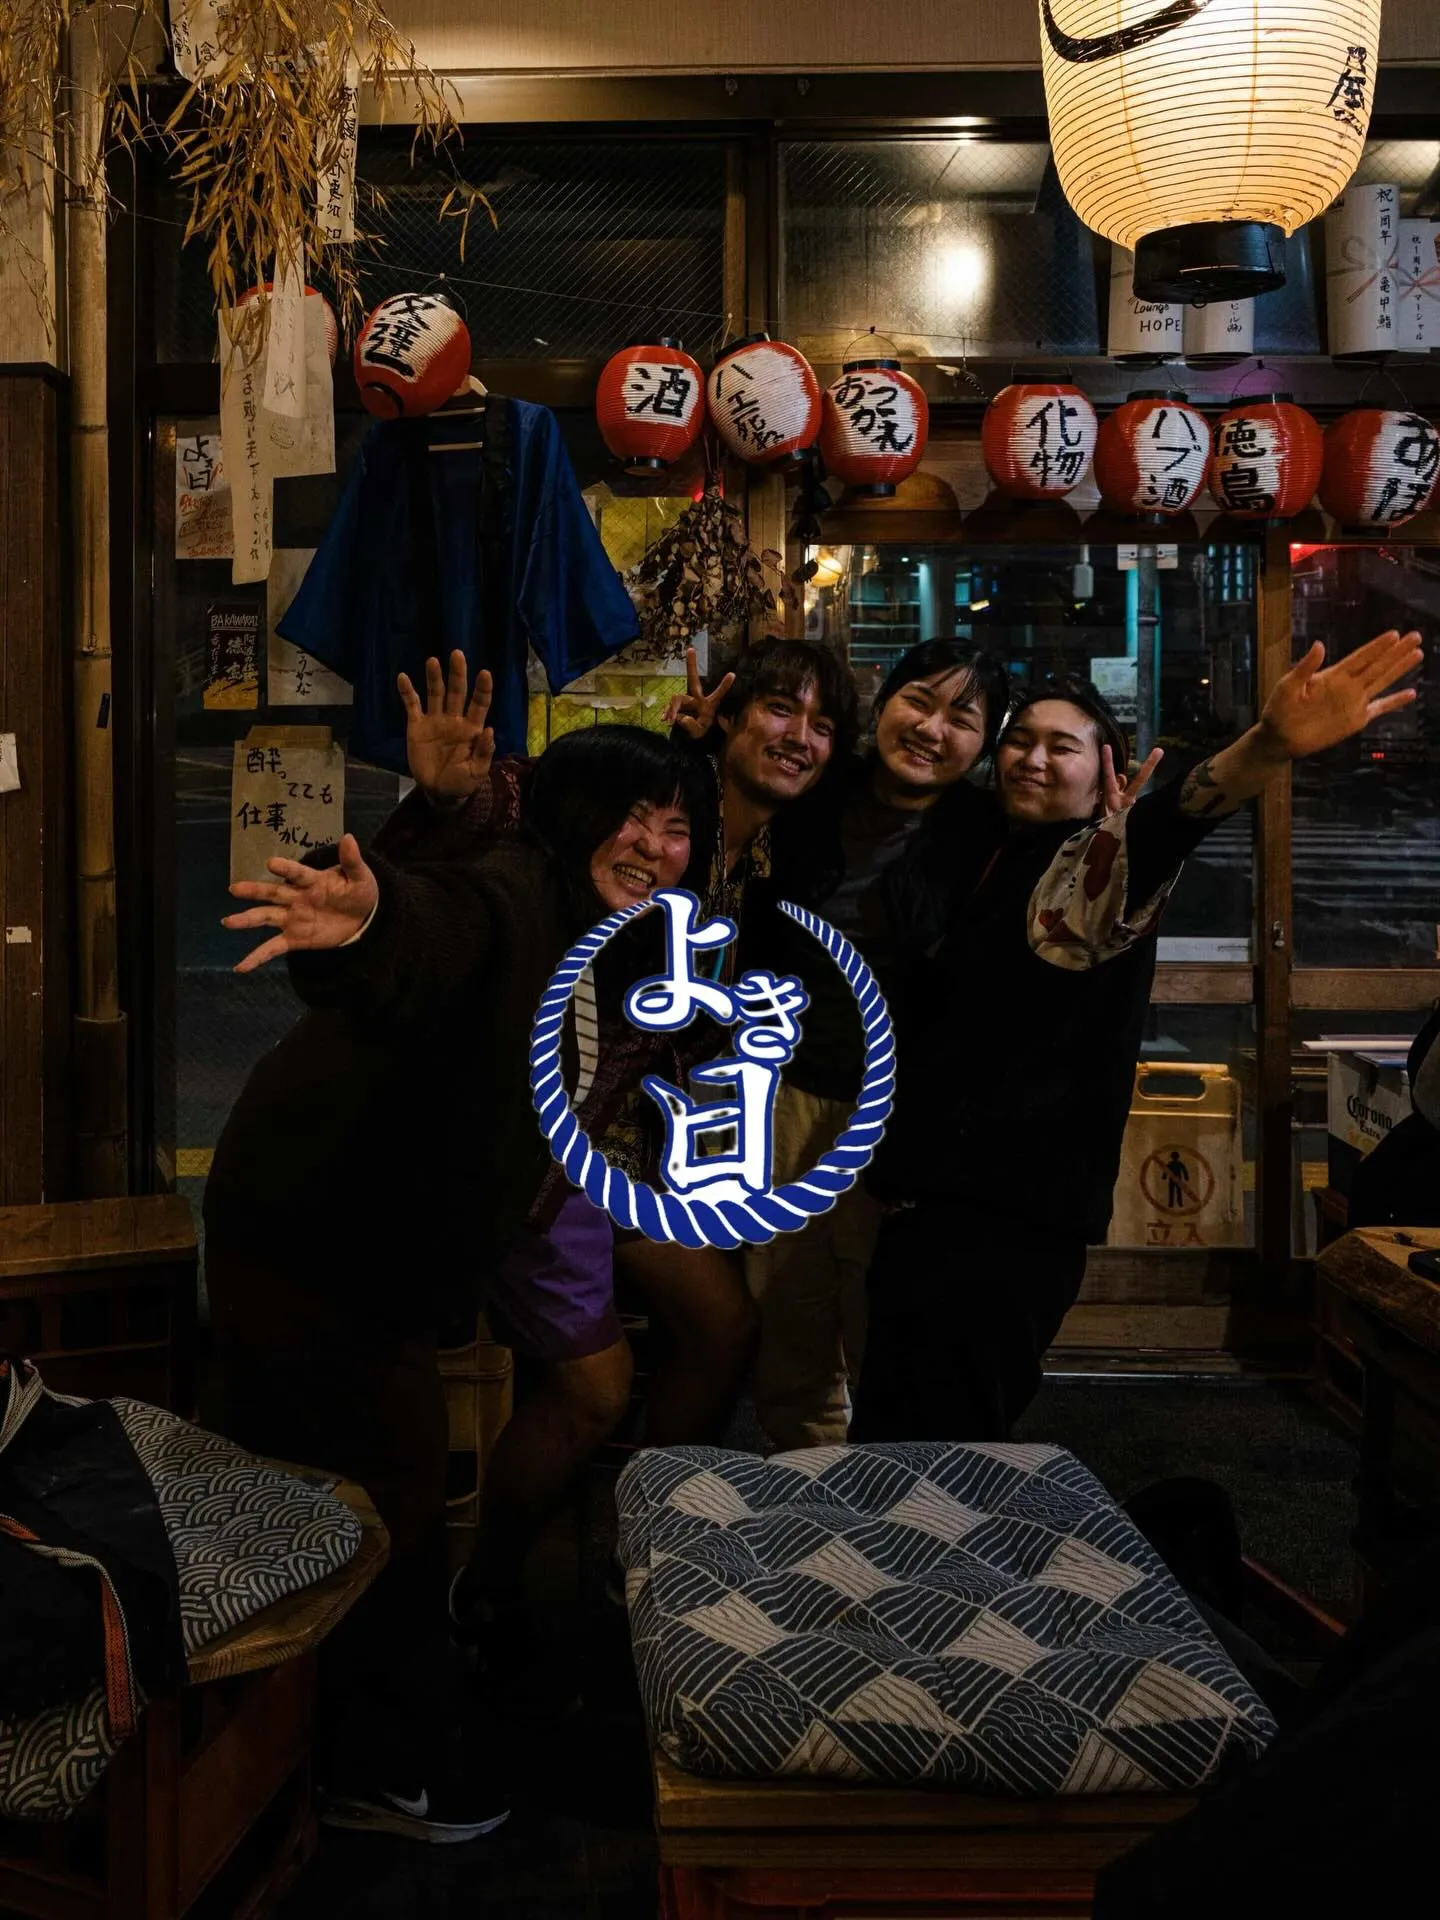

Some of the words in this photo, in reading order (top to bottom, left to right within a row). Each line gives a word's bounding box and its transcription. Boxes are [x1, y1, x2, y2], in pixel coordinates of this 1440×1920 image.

[1140, 318, 1181, 332] HOPE
[626, 365, 691, 418] 酒
[1026, 400, 1085, 486] 化物
[1141, 409, 1200, 508] ハブ酒
[1214, 418, 1275, 513] 徳島
[1347, 1095, 1392, 1129] Corona
